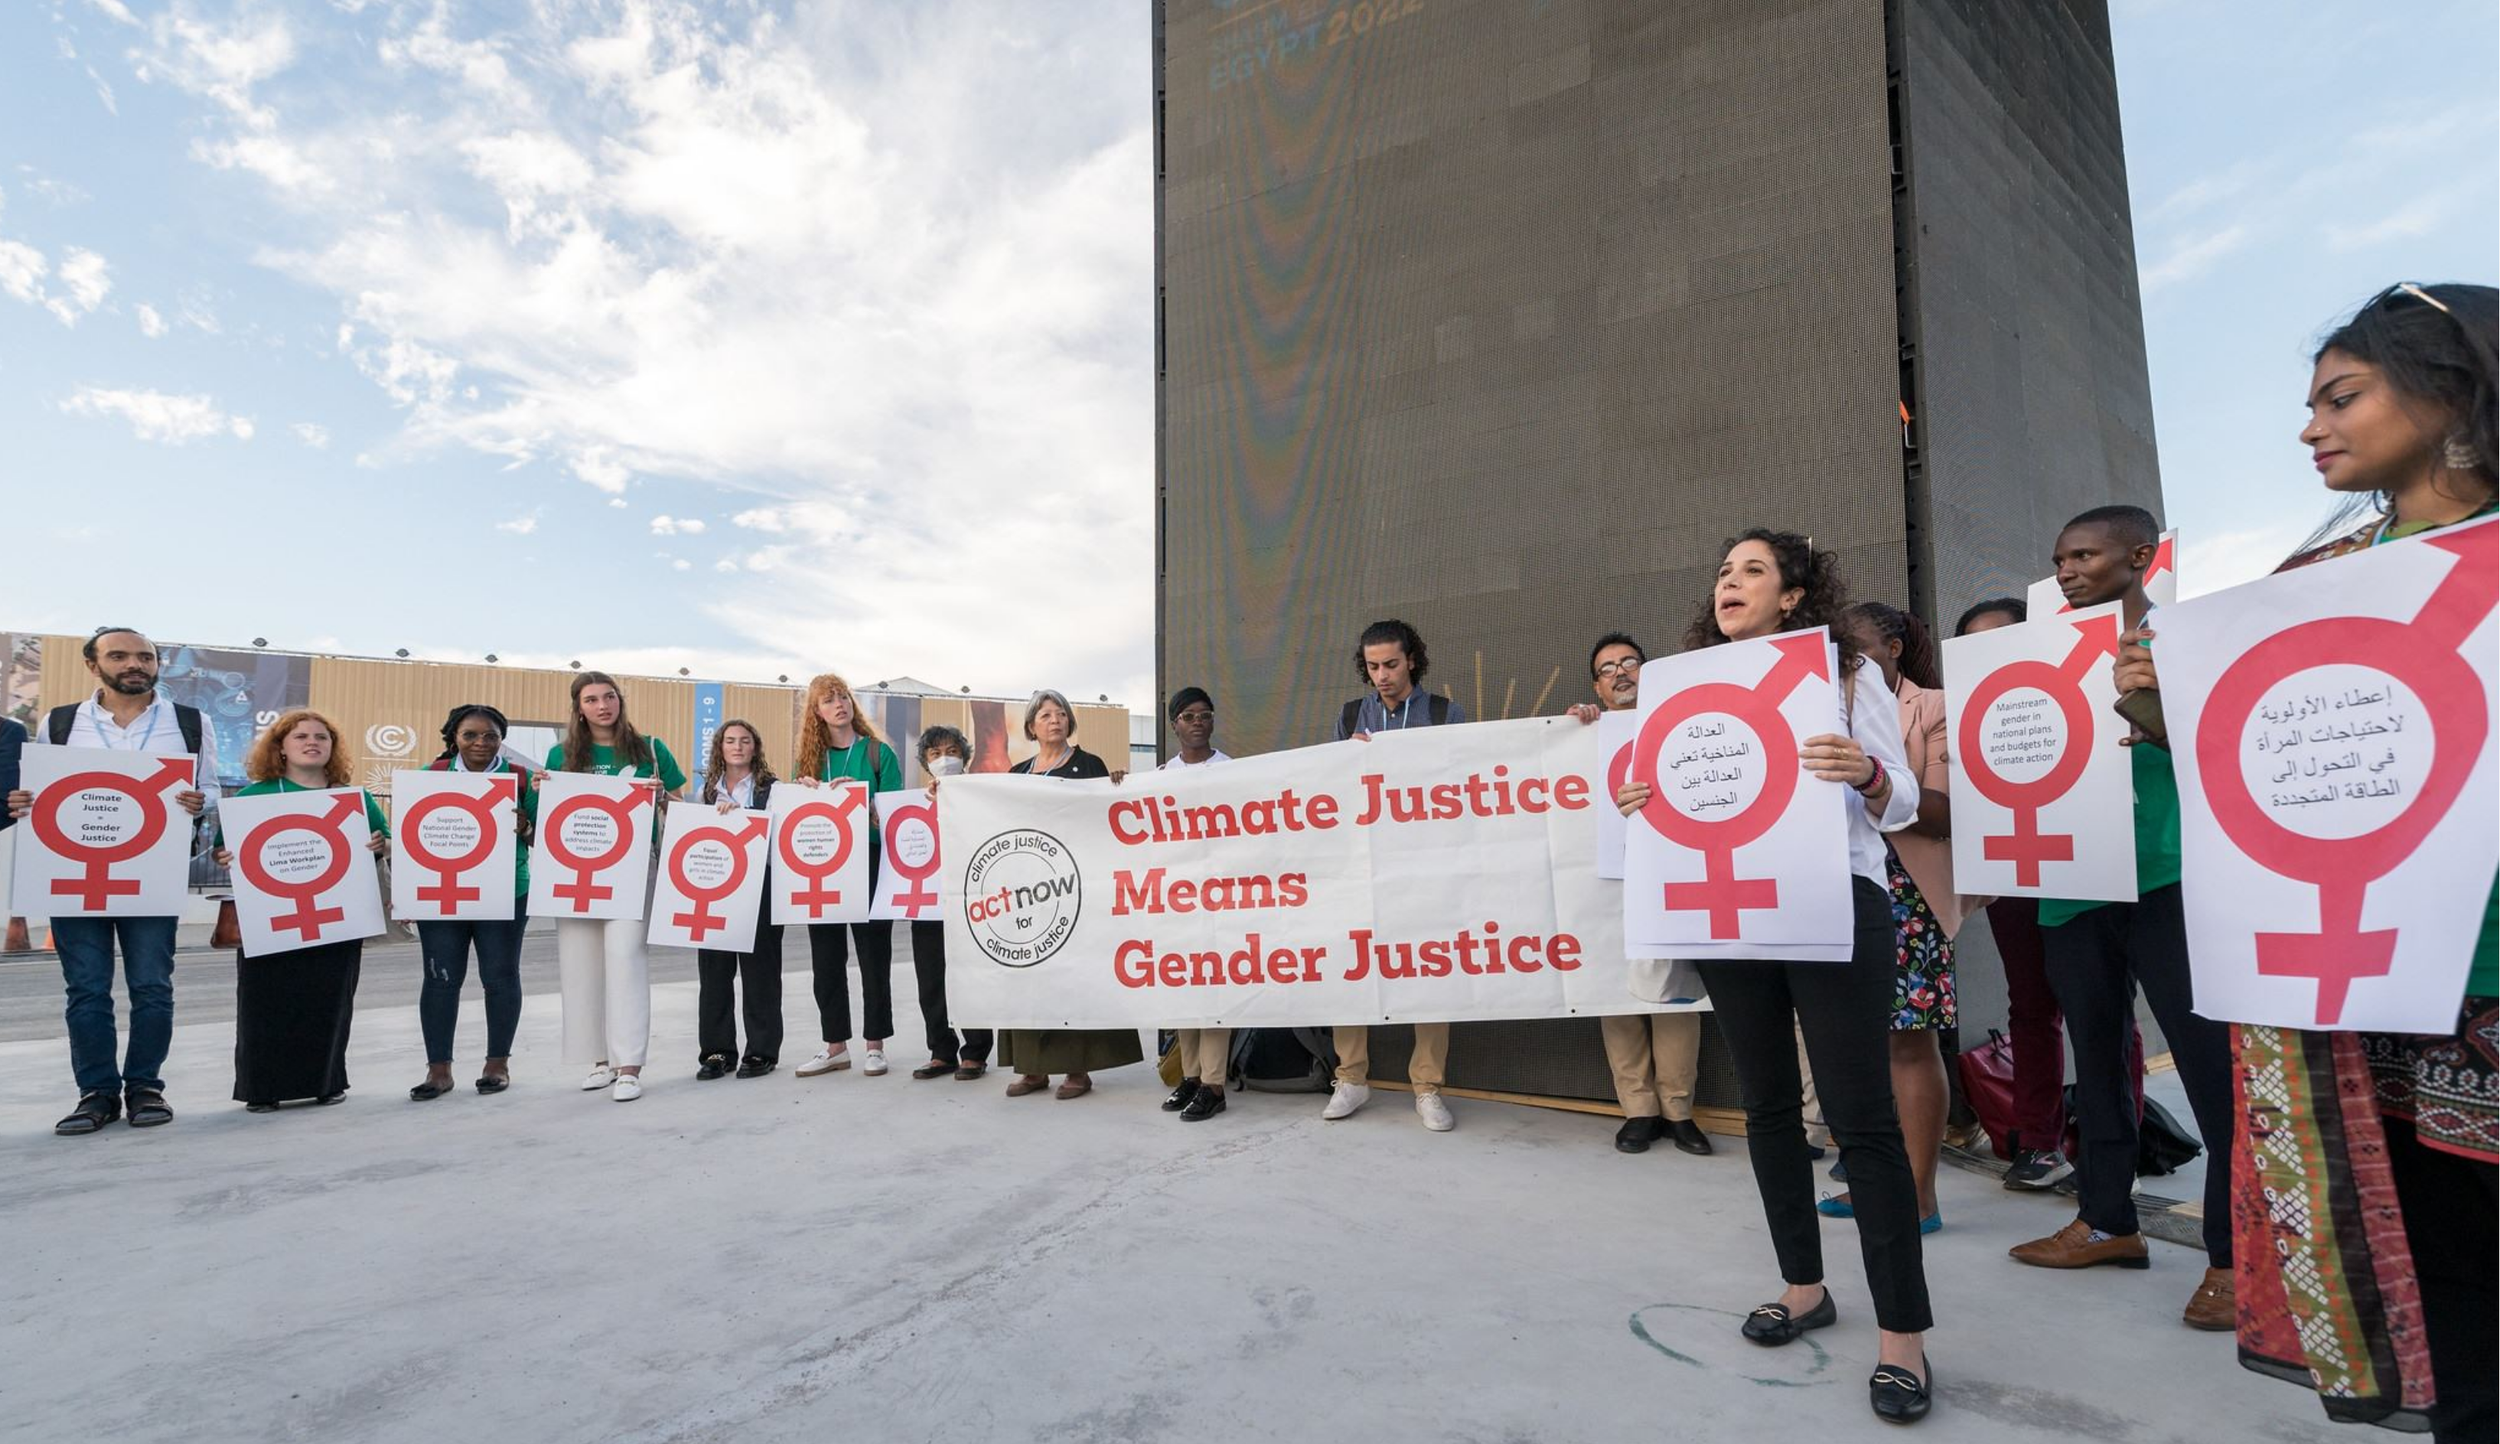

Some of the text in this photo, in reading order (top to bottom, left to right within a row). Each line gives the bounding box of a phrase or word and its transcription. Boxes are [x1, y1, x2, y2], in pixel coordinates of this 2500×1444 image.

[703, 697, 716, 705] 9
[1996, 698, 2048, 712] Mainstream
[2261, 685, 2392, 724] إعطاء الأولوية
[2001, 712, 2041, 726] gender in
[1688, 723, 1725, 739] العدالة
[1993, 725, 2052, 739] national plans
[2256, 714, 2404, 754] لاحتياجات المرأة
[701, 726, 715, 776] OOMS
[1990, 738, 2056, 752] and budgets for
[1701, 743, 1749, 763] المناخية
[1994, 753, 2053, 766] climate action
[2271, 747, 2395, 784] في التحول إلى
[1682, 767, 1742, 789] العدالة بين
[81, 793, 122, 802] Climate
[2271, 778, 2401, 808] الطاقة المتجددة
[82, 804, 119, 812] Justice
[1108, 765, 1590, 846] Climate Justice
[1690, 792, 1738, 812] الجنسين
[436, 816, 463, 824] Support
[81, 823, 120, 832] Gender
[81, 834, 117, 842] Justice
[267, 840, 308, 850] Implement
[278, 847, 314, 857] Enhanced
[971, 835, 1058, 883] climate justice
[289, 855, 326, 864] Workplan
[291, 864, 318, 872] Gender
[1111, 867, 1308, 916] Means
[1016, 916, 1033, 930] for
[986, 916, 1069, 961] climate justice
[1114, 921, 1582, 988] Gender Justice
